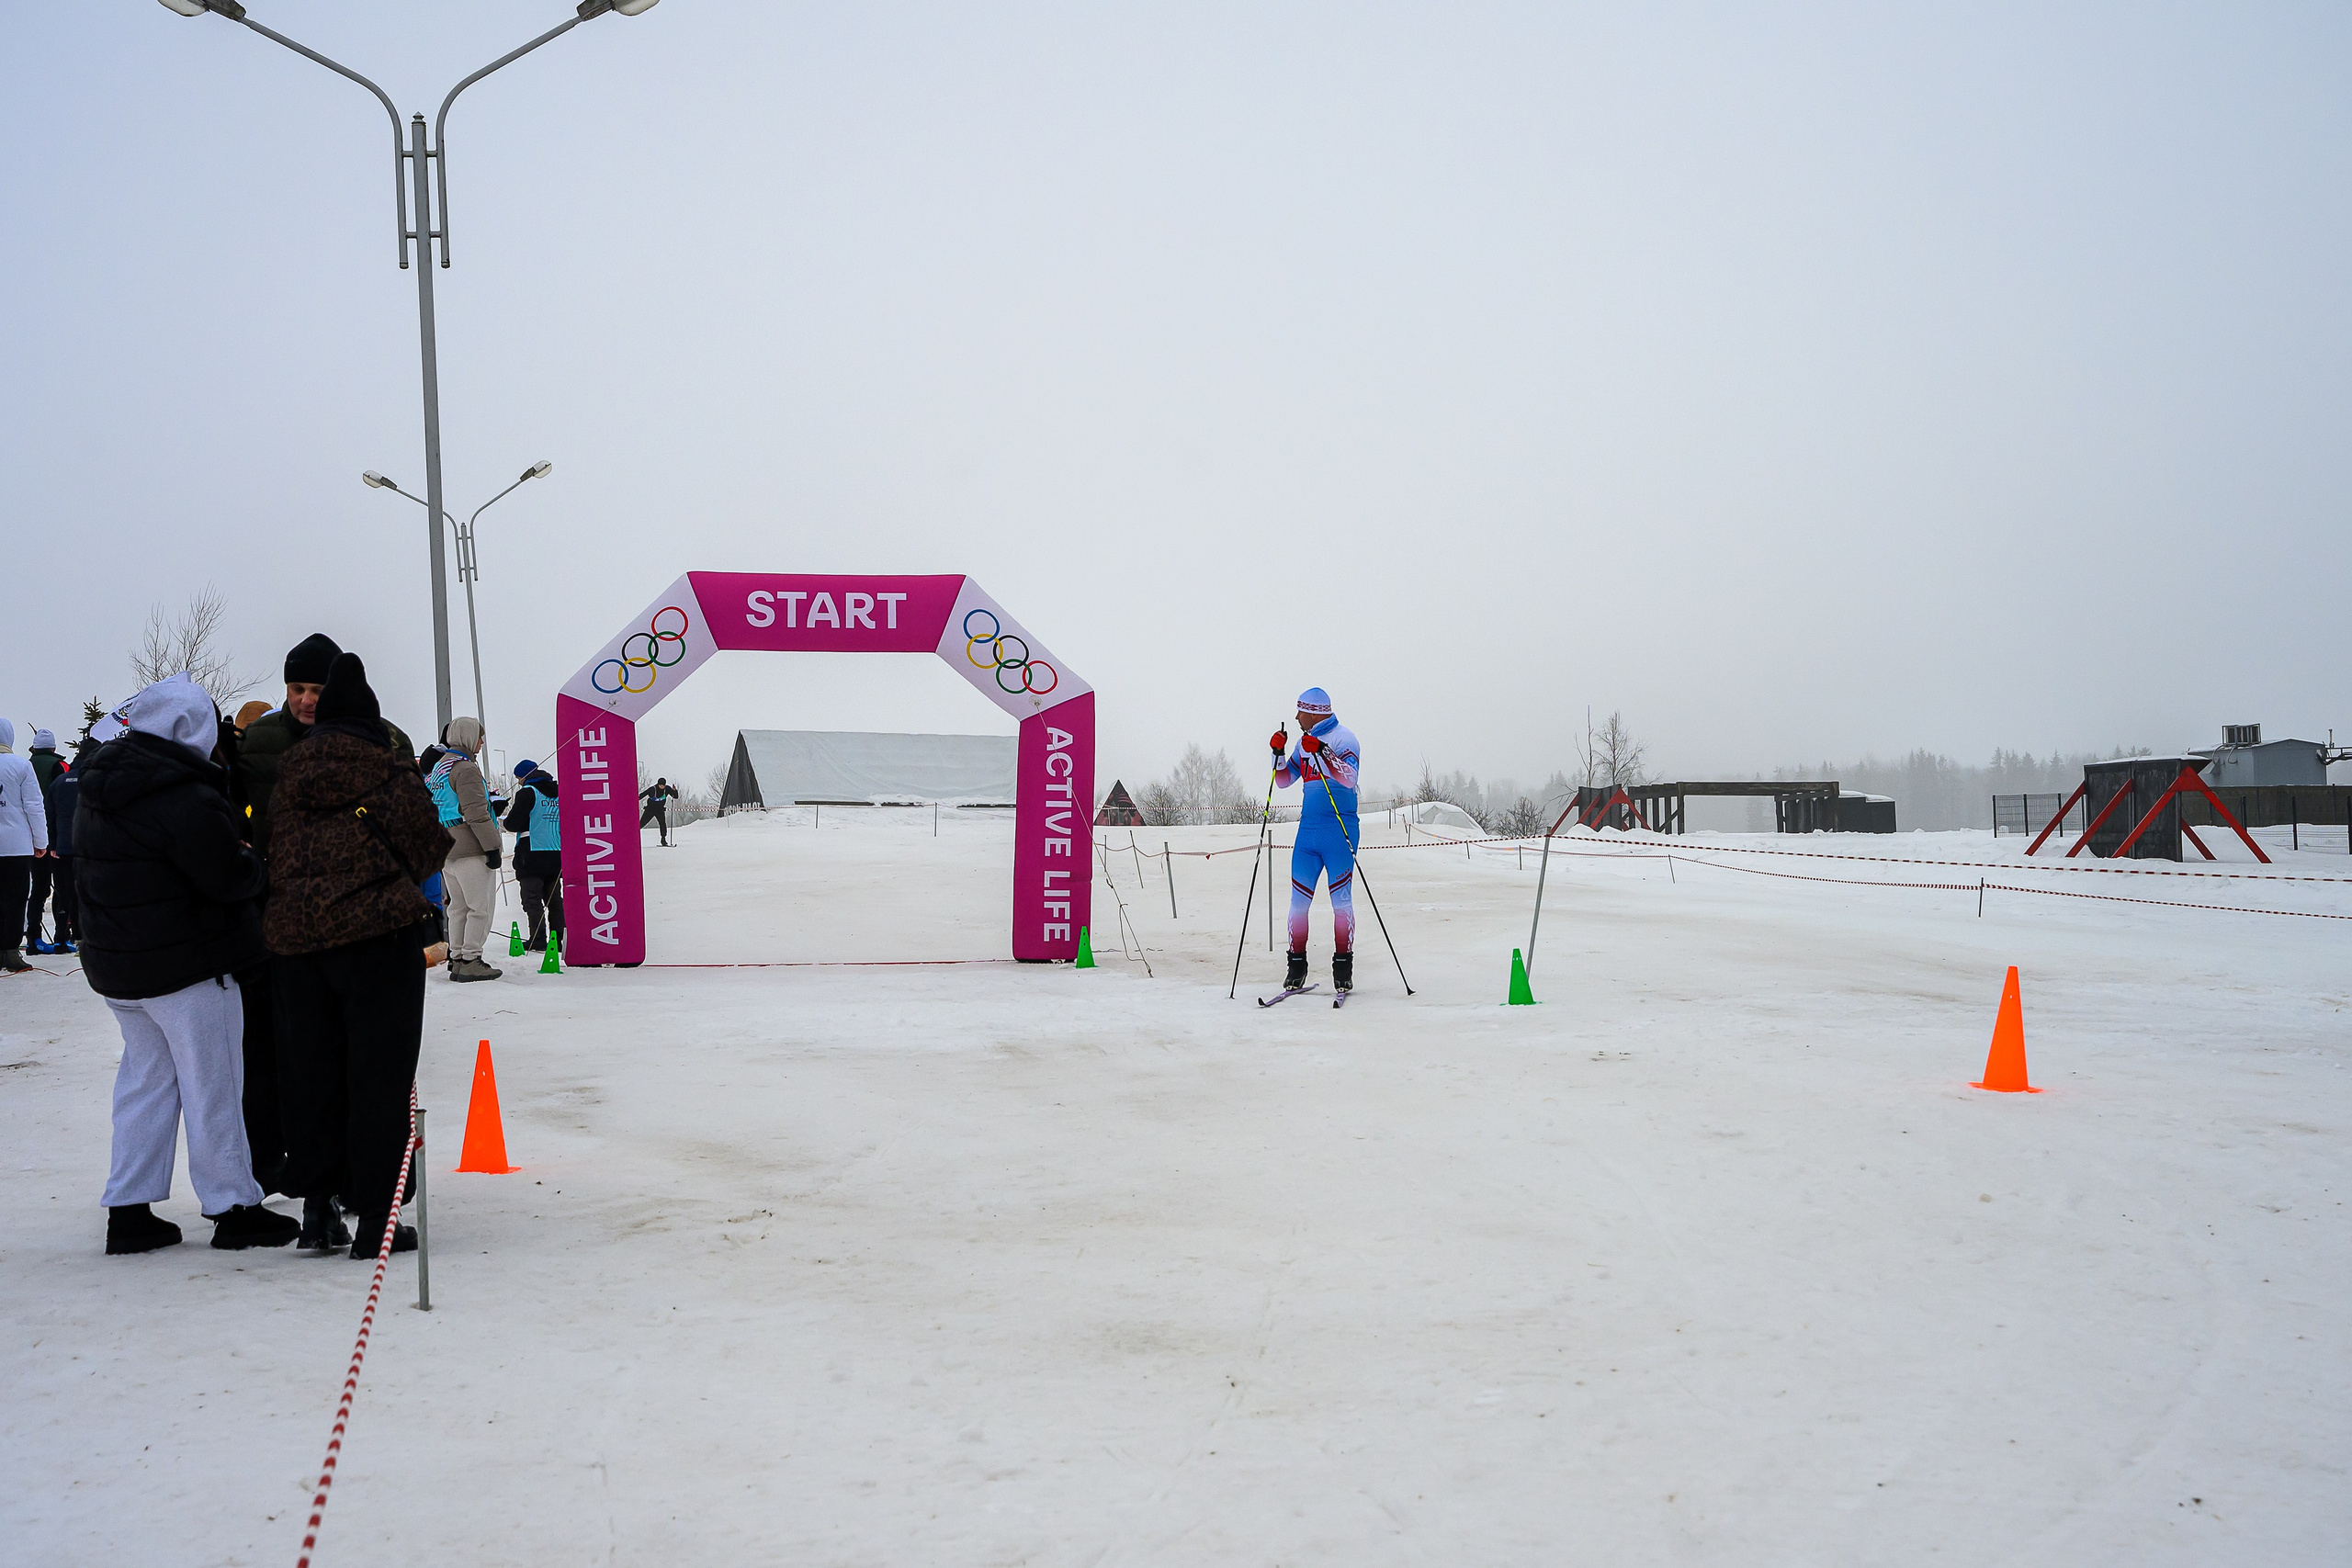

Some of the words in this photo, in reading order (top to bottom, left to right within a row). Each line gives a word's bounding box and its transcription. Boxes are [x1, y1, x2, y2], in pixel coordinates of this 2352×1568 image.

[746, 590, 907, 629] START
[578, 727, 610, 801] LIFE
[1044, 726, 1074, 857] ACTIVE
[583, 814, 619, 945] ACTIVE
[1044, 870, 1071, 942] LIFE
